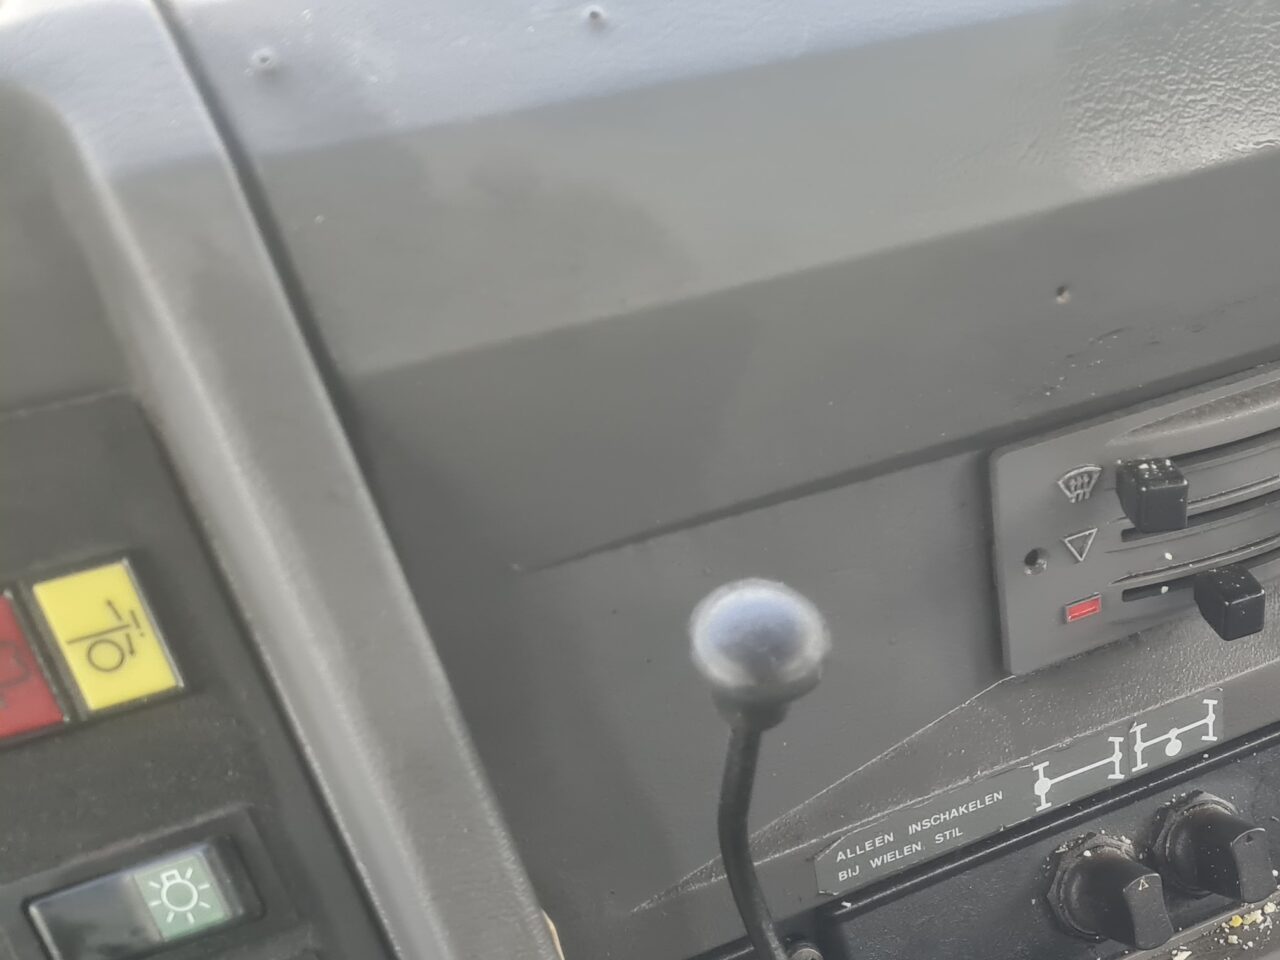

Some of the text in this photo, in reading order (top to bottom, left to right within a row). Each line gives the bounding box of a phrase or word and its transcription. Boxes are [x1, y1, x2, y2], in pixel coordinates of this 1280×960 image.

[836, 790, 1003, 863] ALLEEN INSCHAKELEN
[838, 827, 964, 882] BIJ WIELEN STIL
